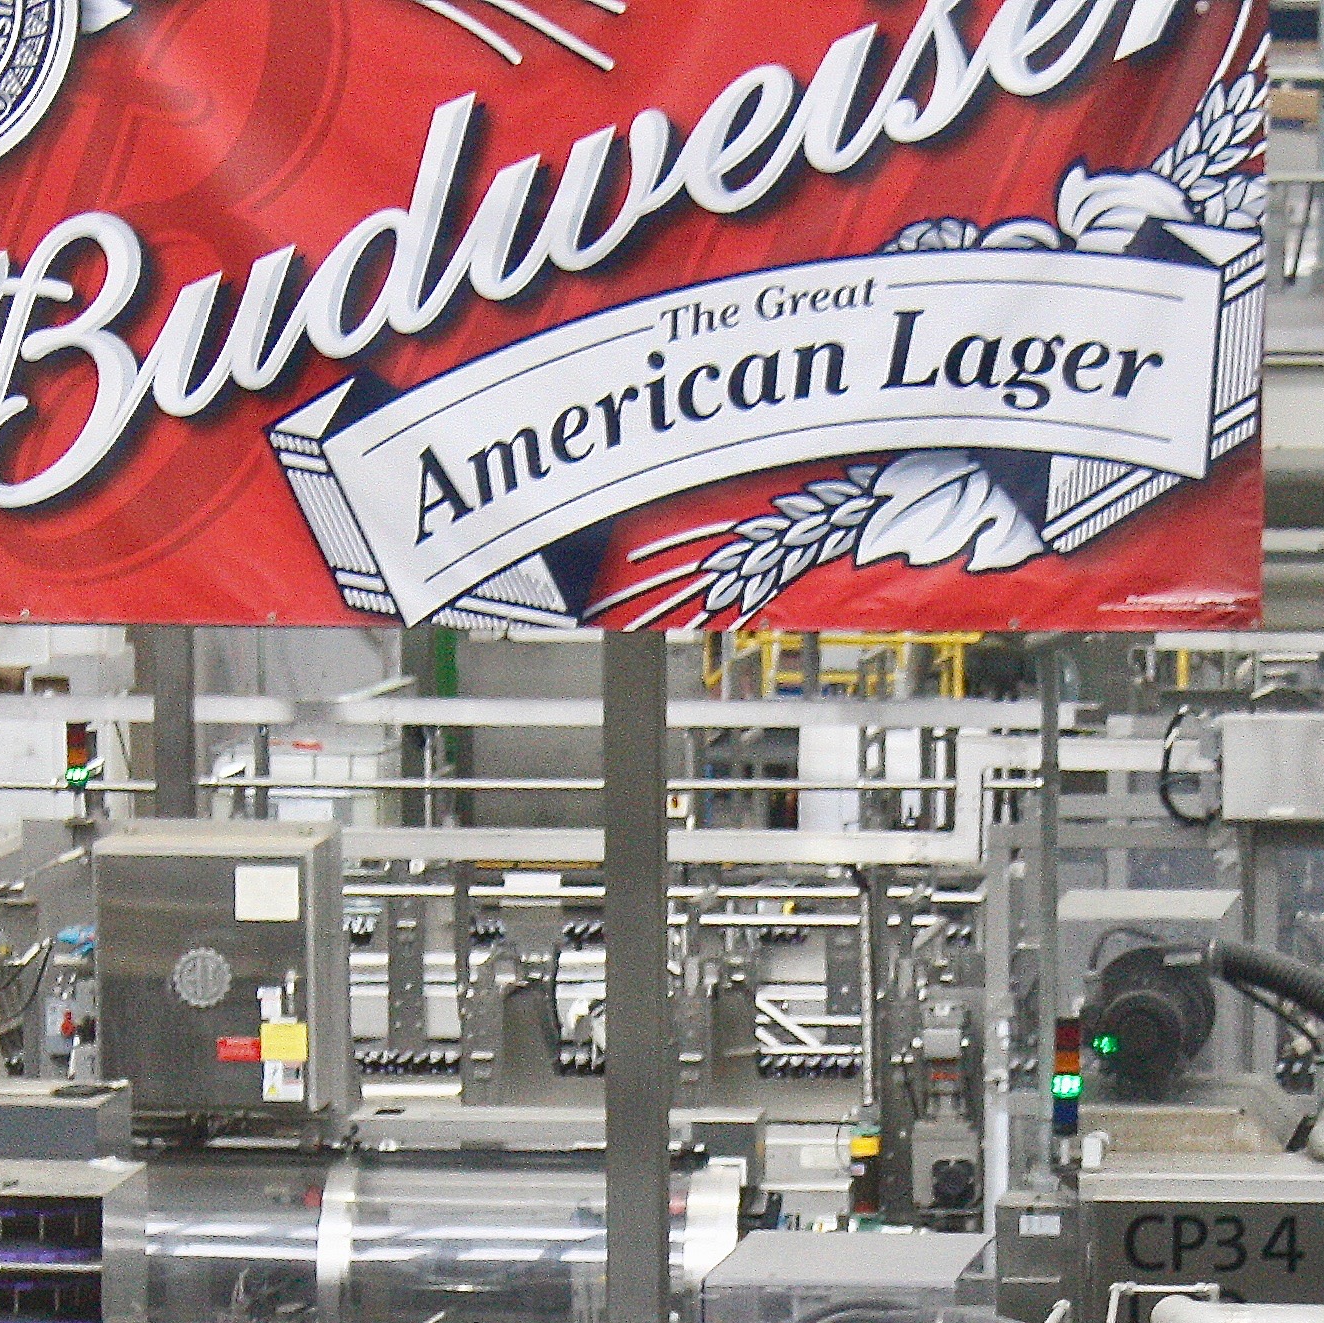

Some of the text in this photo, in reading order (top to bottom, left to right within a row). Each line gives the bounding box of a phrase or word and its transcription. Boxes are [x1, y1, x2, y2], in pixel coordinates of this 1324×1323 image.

[658, 275, 879, 343] The Great
[413, 308, 1163, 547] American Lager
[1124, 1213, 1306, 1273] CP34
